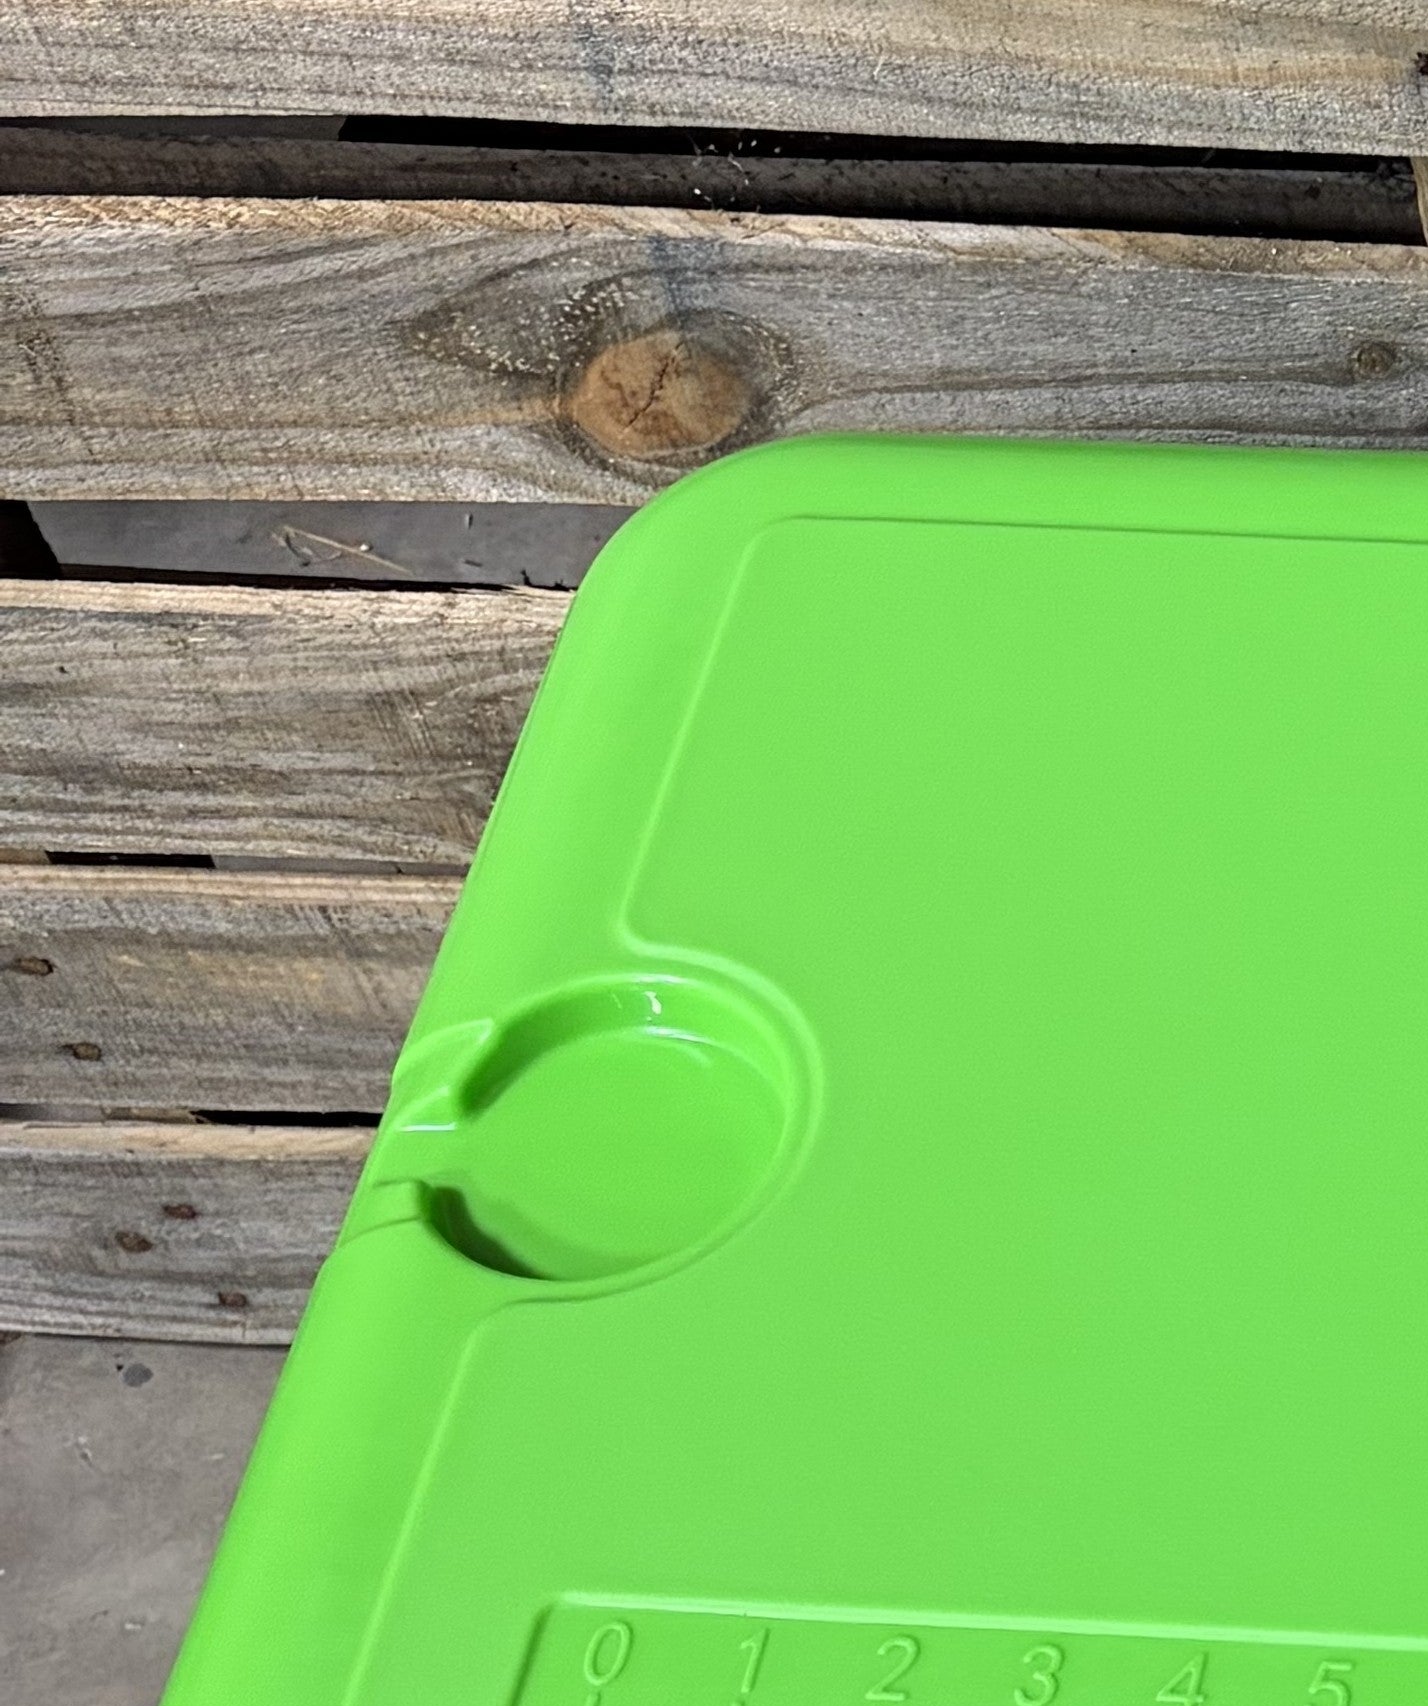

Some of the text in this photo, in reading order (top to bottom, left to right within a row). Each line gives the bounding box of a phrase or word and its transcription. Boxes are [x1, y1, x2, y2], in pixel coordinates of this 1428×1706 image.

[583, 1619, 633, 1687] 0
[738, 1627, 770, 1695] 1
[865, 1635, 922, 1704] 2
